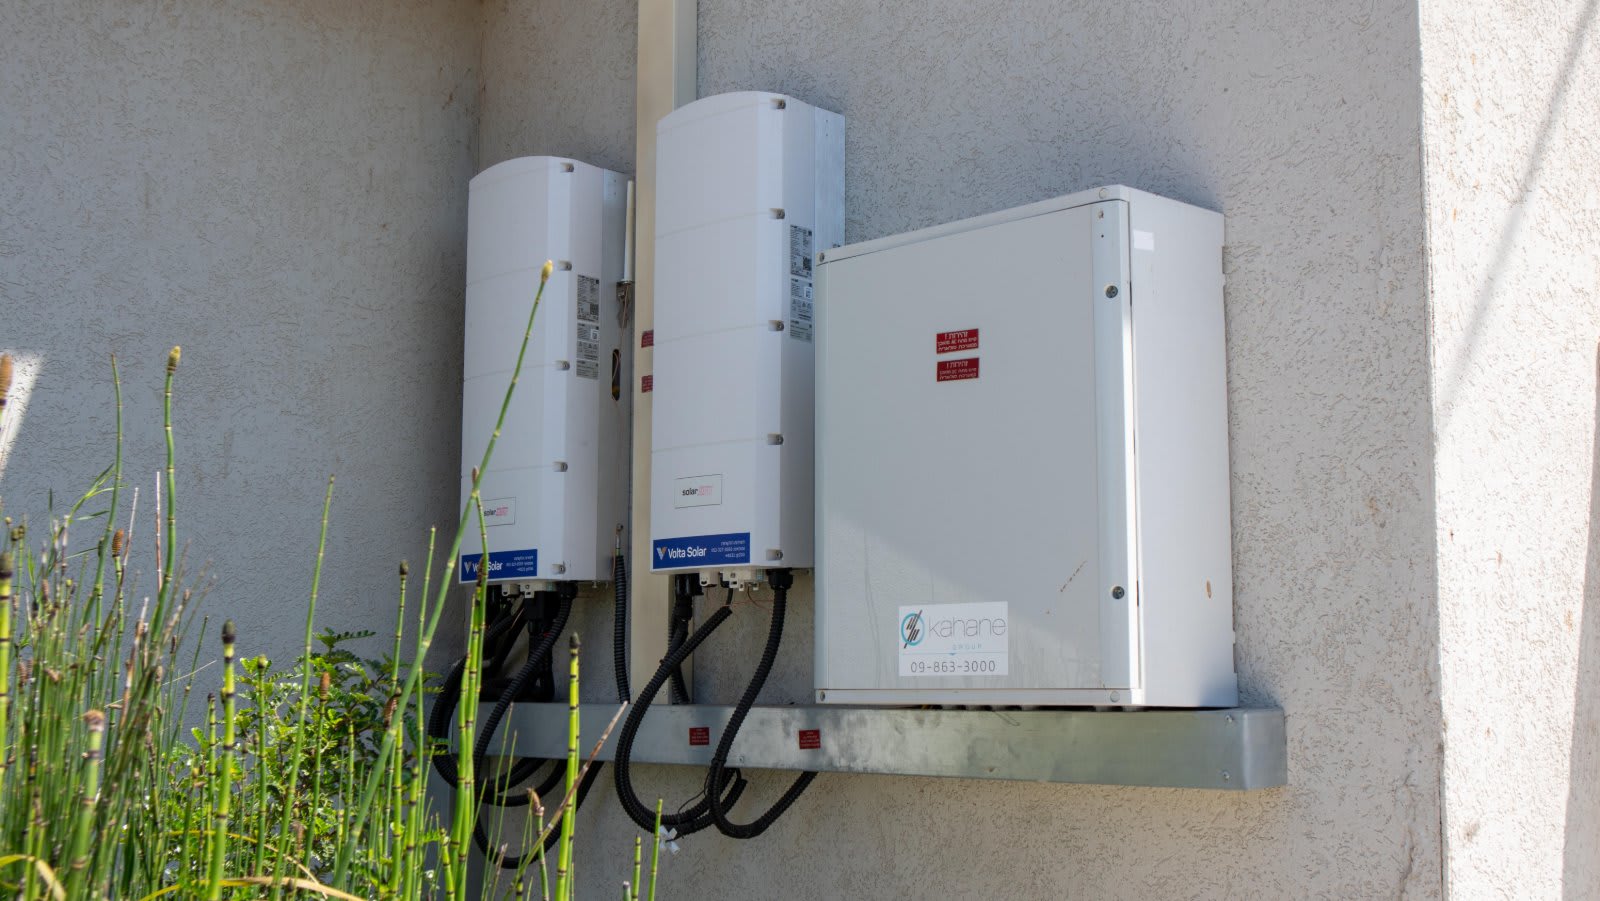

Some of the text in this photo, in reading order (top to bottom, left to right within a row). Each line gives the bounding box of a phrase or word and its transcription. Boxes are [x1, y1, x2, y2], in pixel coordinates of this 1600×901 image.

[668, 548, 686, 559] Volta
[686, 546, 707, 558] Solar
[488, 560, 504, 571] Solar
[928, 616, 1008, 638] kahane
[910, 660, 996, 673] 09-863-3000
